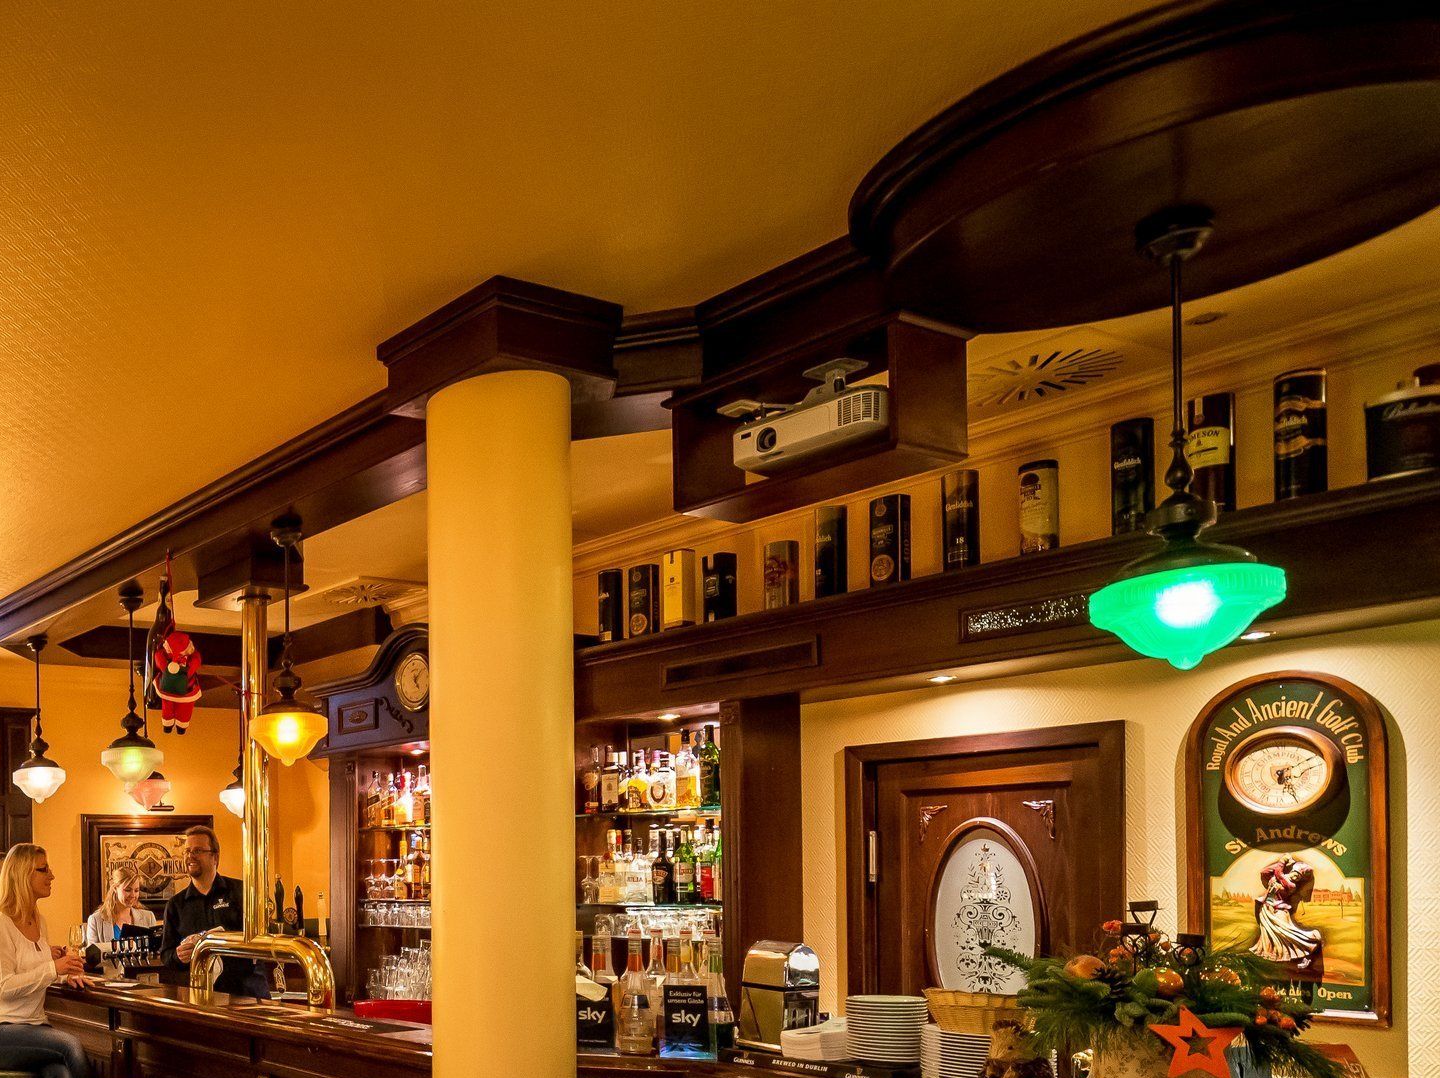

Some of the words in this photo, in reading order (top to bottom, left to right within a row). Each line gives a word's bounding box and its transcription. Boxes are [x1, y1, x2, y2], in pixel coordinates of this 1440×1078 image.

[1188, 430, 1220, 442] MESON
[1246, 691, 1324, 724] Ancient
[1215, 707, 1252, 742] And
[1316, 699, 1362, 735] Golf
[1207, 737, 1230, 770] Royal
[1341, 732, 1364, 764] Club
[1256, 825, 1348, 856] Andrews
[669, 990, 692, 998] Exklusiv
[693, 990, 702, 998] für
[1317, 987, 1353, 1001] Open
[578, 1007, 606, 1024] sky
[671, 1009, 701, 1027] sky
[733, 1056, 755, 1066] GUINNESS
[771, 1058, 796, 1068] BREWED
[797, 1061, 805, 1069] IN
[805, 1063, 829, 1073] DUBLIN
